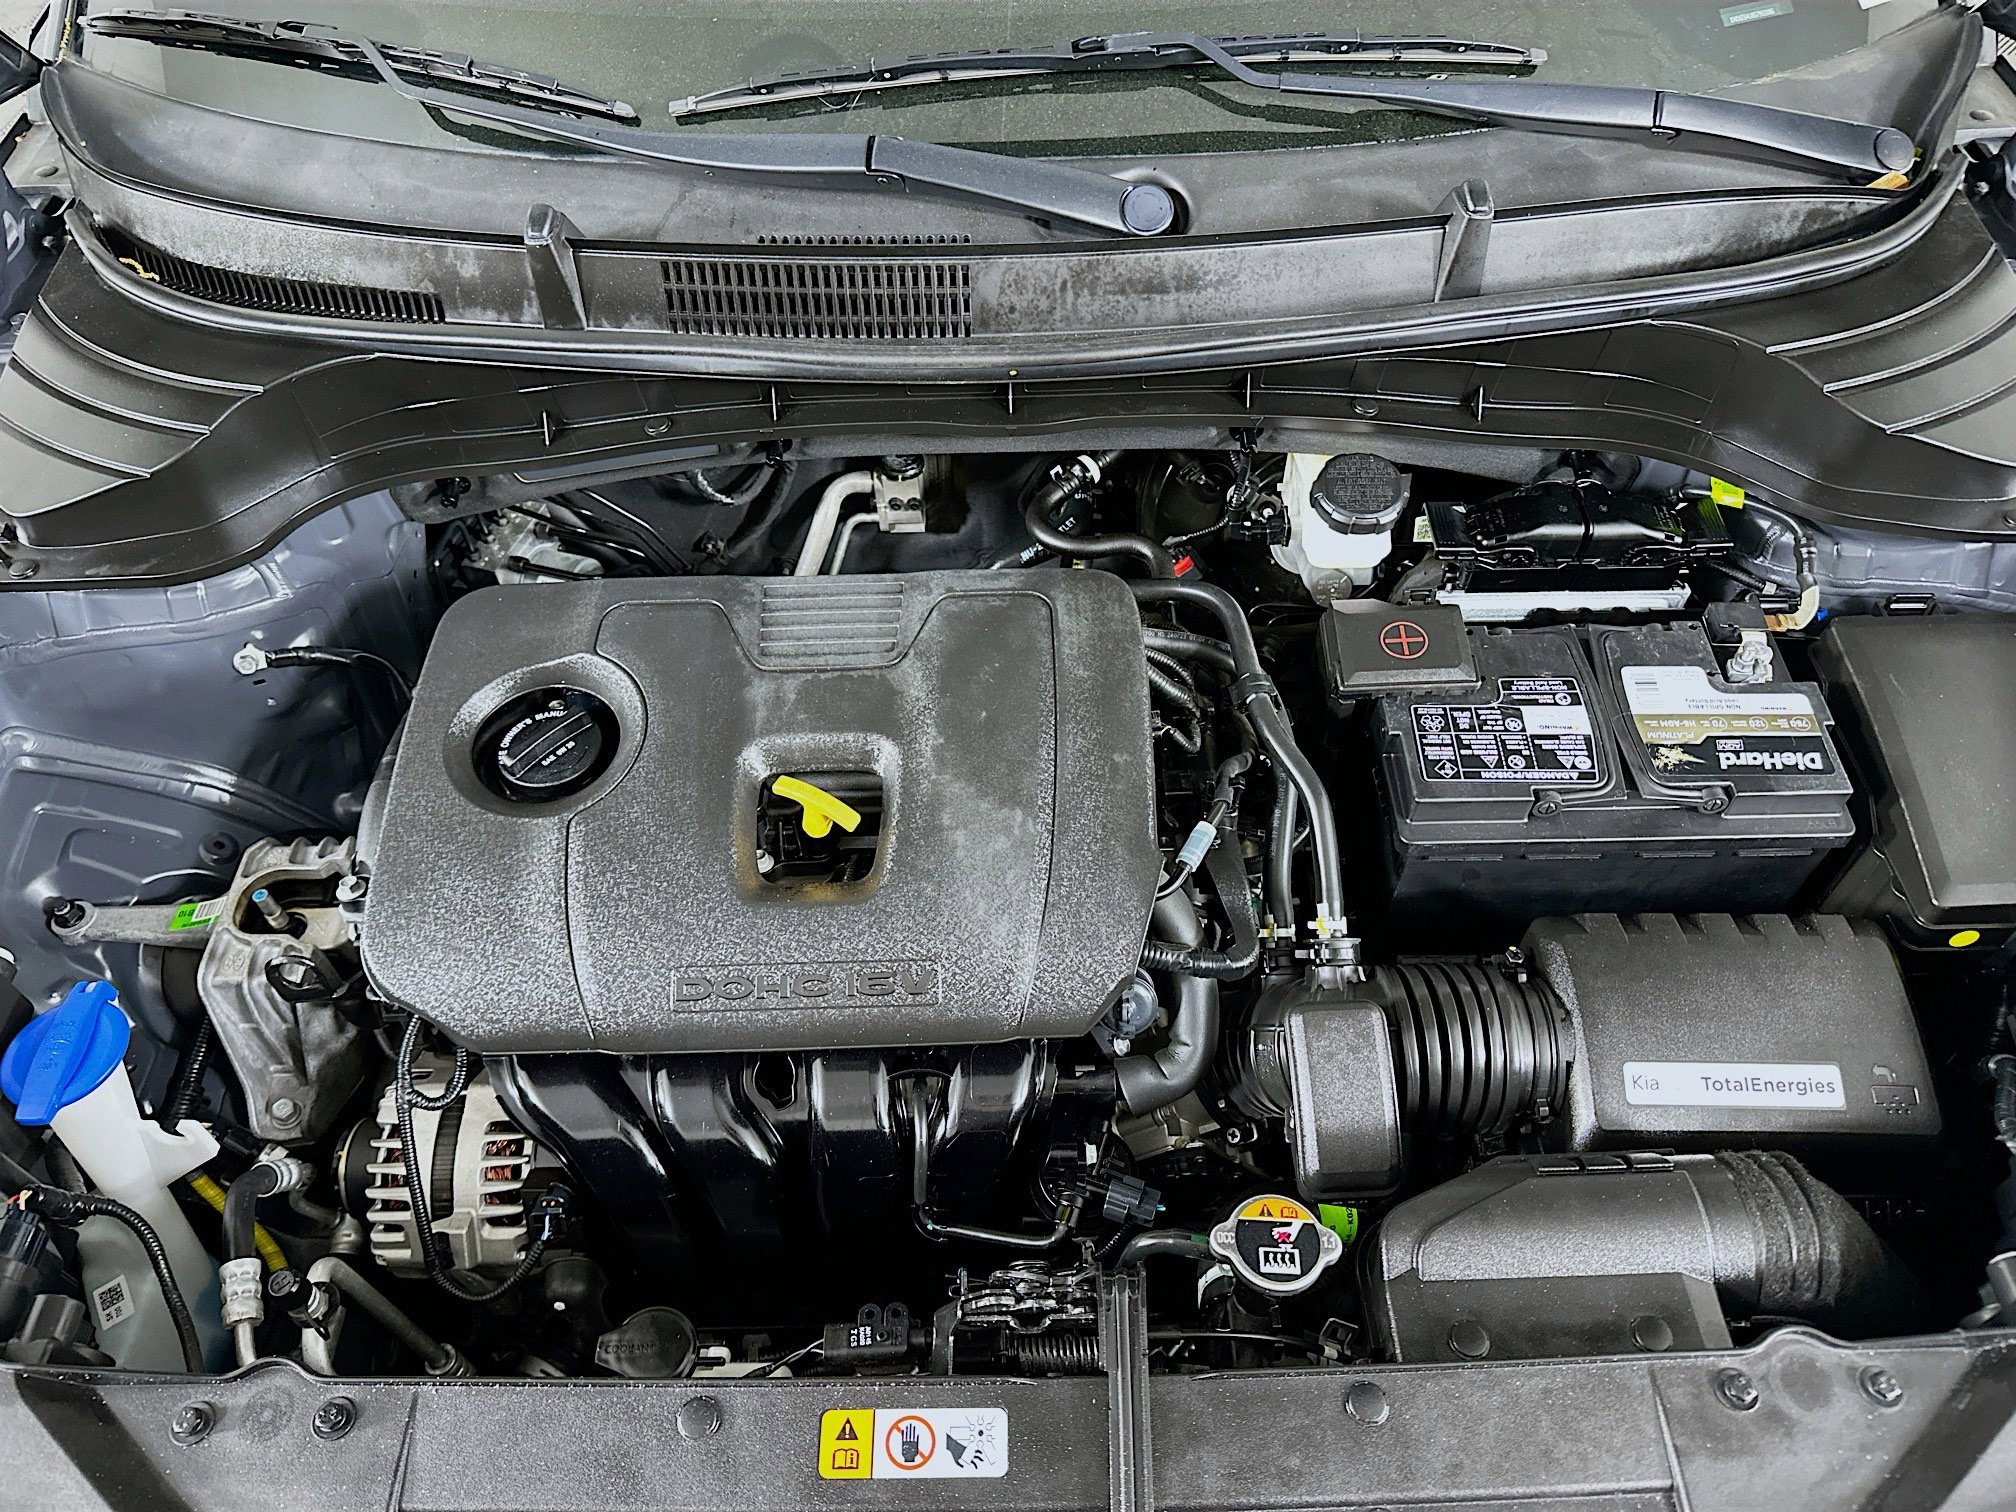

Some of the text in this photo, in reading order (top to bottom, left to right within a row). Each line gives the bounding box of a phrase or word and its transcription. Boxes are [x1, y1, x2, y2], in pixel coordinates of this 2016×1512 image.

[178, 909, 195, 918] B10
[675, 970, 938, 1002] DOHC 16V
[1632, 1075, 1836, 1096] Kia TotalEnergies
[106, 1311, 114, 1322] SK
[850, 1328, 858, 1348] TGS
